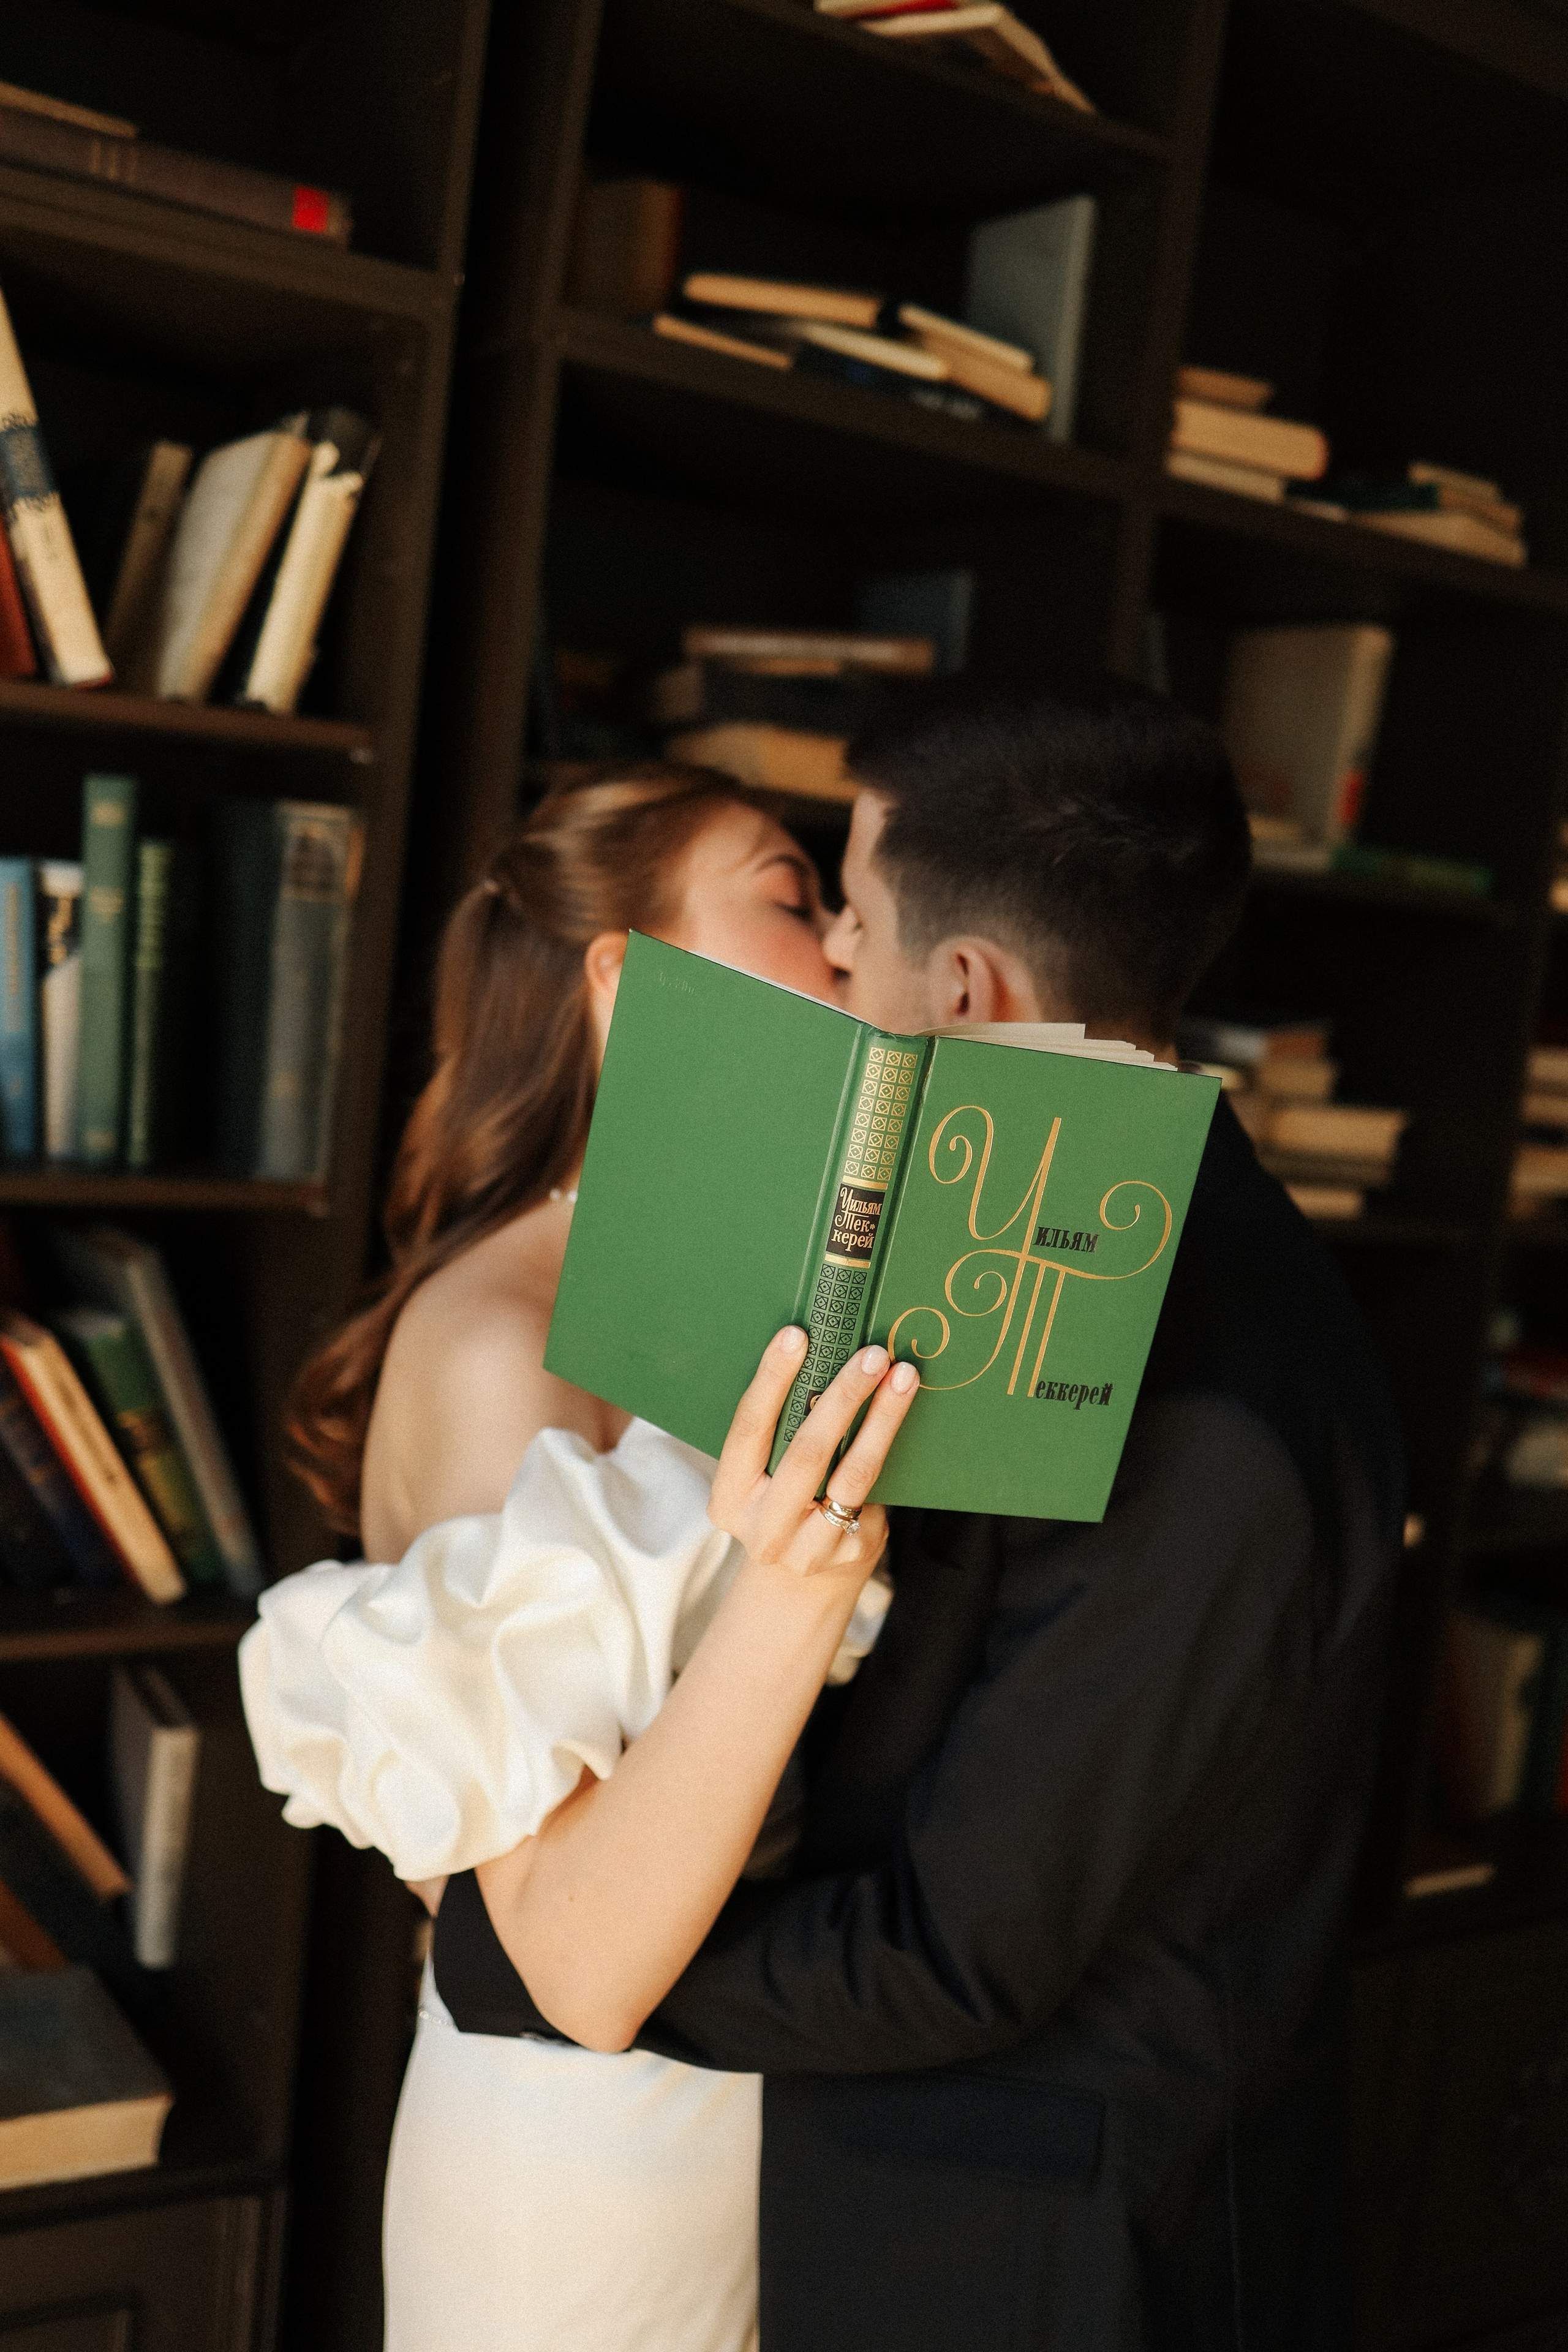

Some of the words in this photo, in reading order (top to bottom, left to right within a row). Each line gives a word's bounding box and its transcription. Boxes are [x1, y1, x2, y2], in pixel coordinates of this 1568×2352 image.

[840, 1186, 883, 1215] Уильям
[929, 1105, 1100, 1256] Уильям
[831, 1229, 875, 1252] керей
[888, 1180, 1173, 1411] Теккерей
